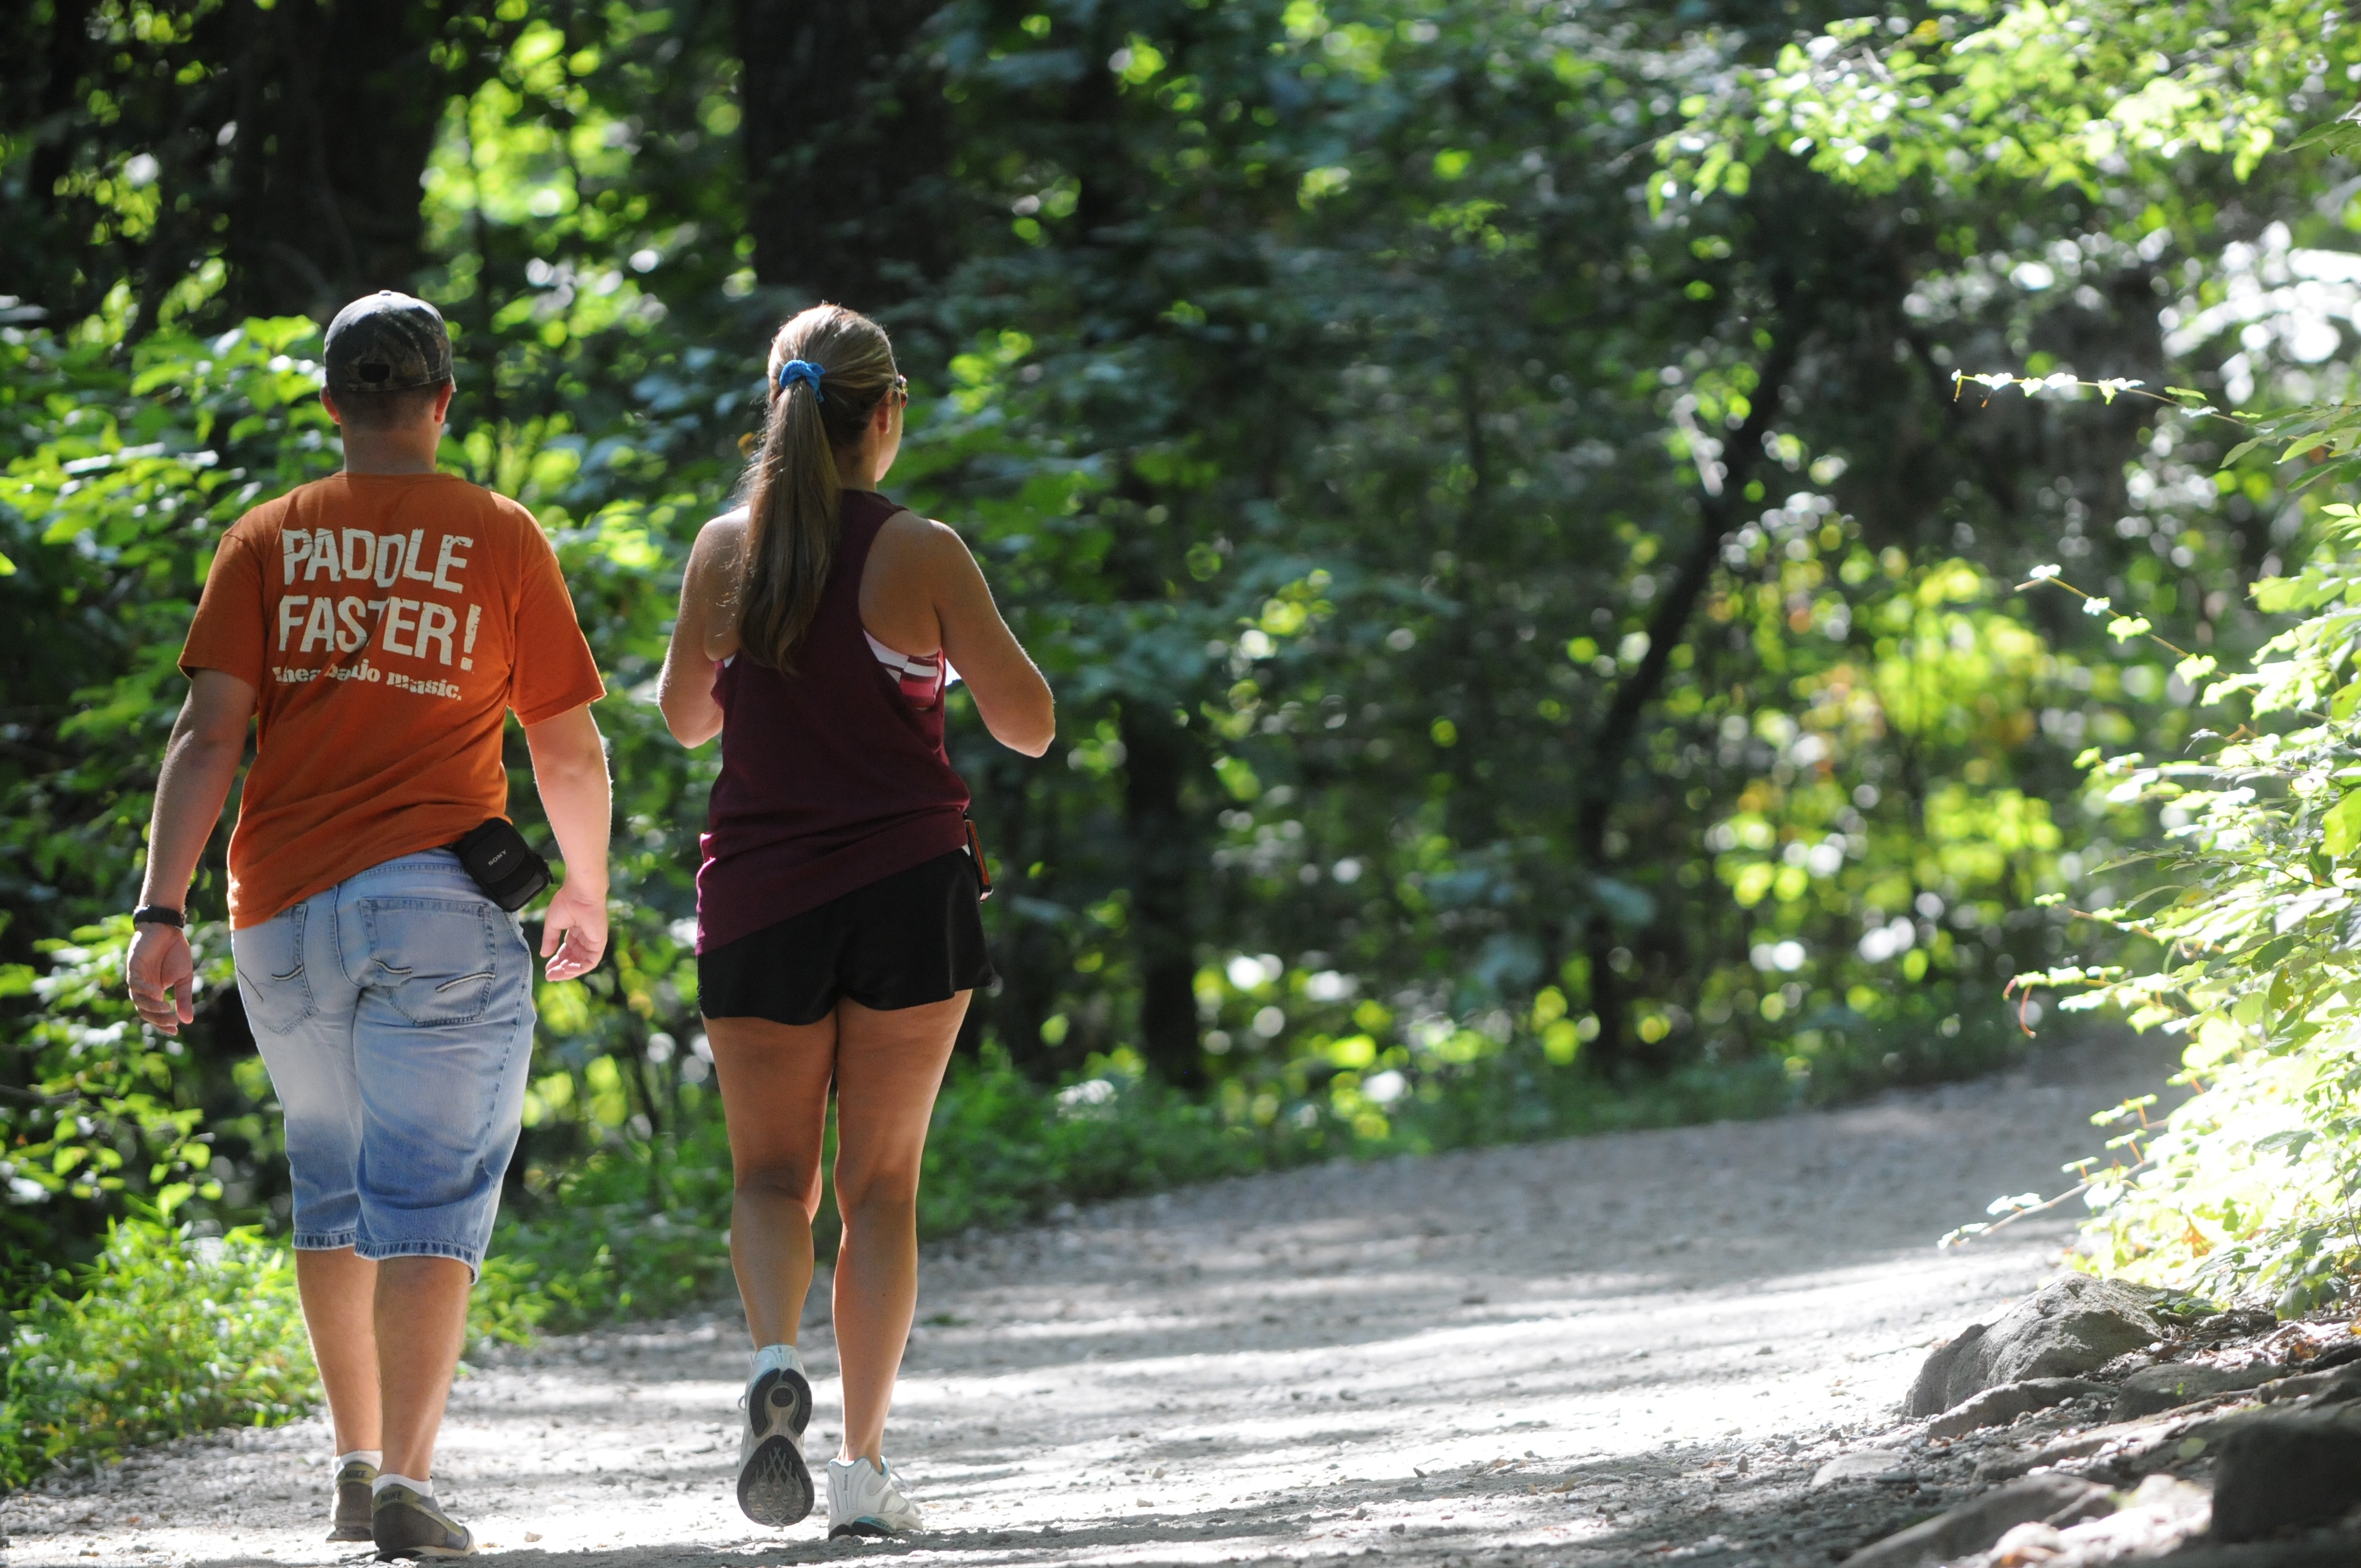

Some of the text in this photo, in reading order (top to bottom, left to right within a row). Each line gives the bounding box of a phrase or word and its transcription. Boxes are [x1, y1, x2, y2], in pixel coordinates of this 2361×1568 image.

[282, 527, 474, 594] PADDLE
[279, 595, 482, 672] FASTER!
[282, 665, 322, 683] hea
[386, 671, 462, 701] music.
[488, 850, 506, 866] SONY
[345, 1469, 367, 1479] NIKE
[380, 1490, 402, 1503] NIKE
